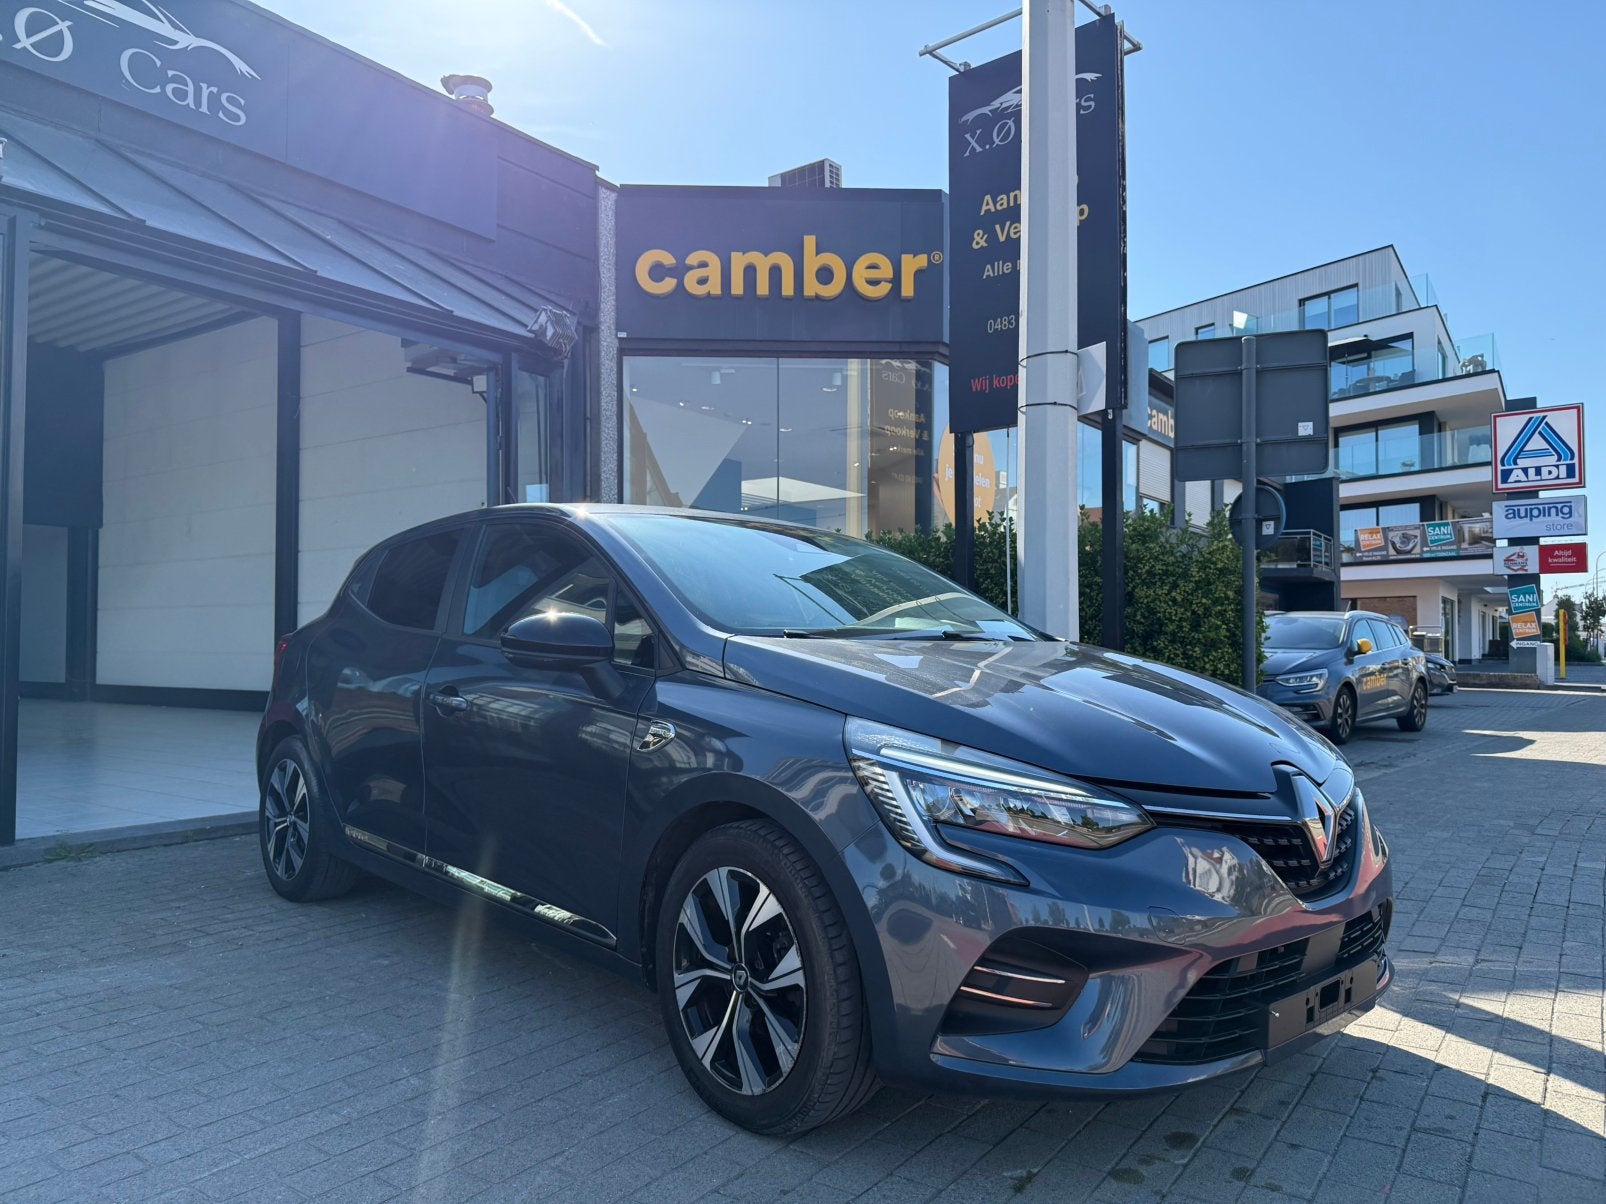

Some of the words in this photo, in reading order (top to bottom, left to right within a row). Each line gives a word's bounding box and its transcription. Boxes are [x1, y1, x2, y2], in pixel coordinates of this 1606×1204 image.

[0, 7, 74, 62] Ø
[119, 48, 247, 126] Cars
[963, 117, 1017, 157] X.Ø
[971, 229, 988, 250] &
[982, 259, 1012, 279] Alle
[987, 314, 1016, 333] 0483
[970, 376, 990, 393] Wij
[993, 373, 1019, 390] kope
[1507, 464, 1567, 483] ALDI
[1504, 503, 1573, 521] auping
[1428, 525, 1451, 536] SANI
[1545, 522, 1574, 532] store
[1511, 593, 1537, 603] SANI
